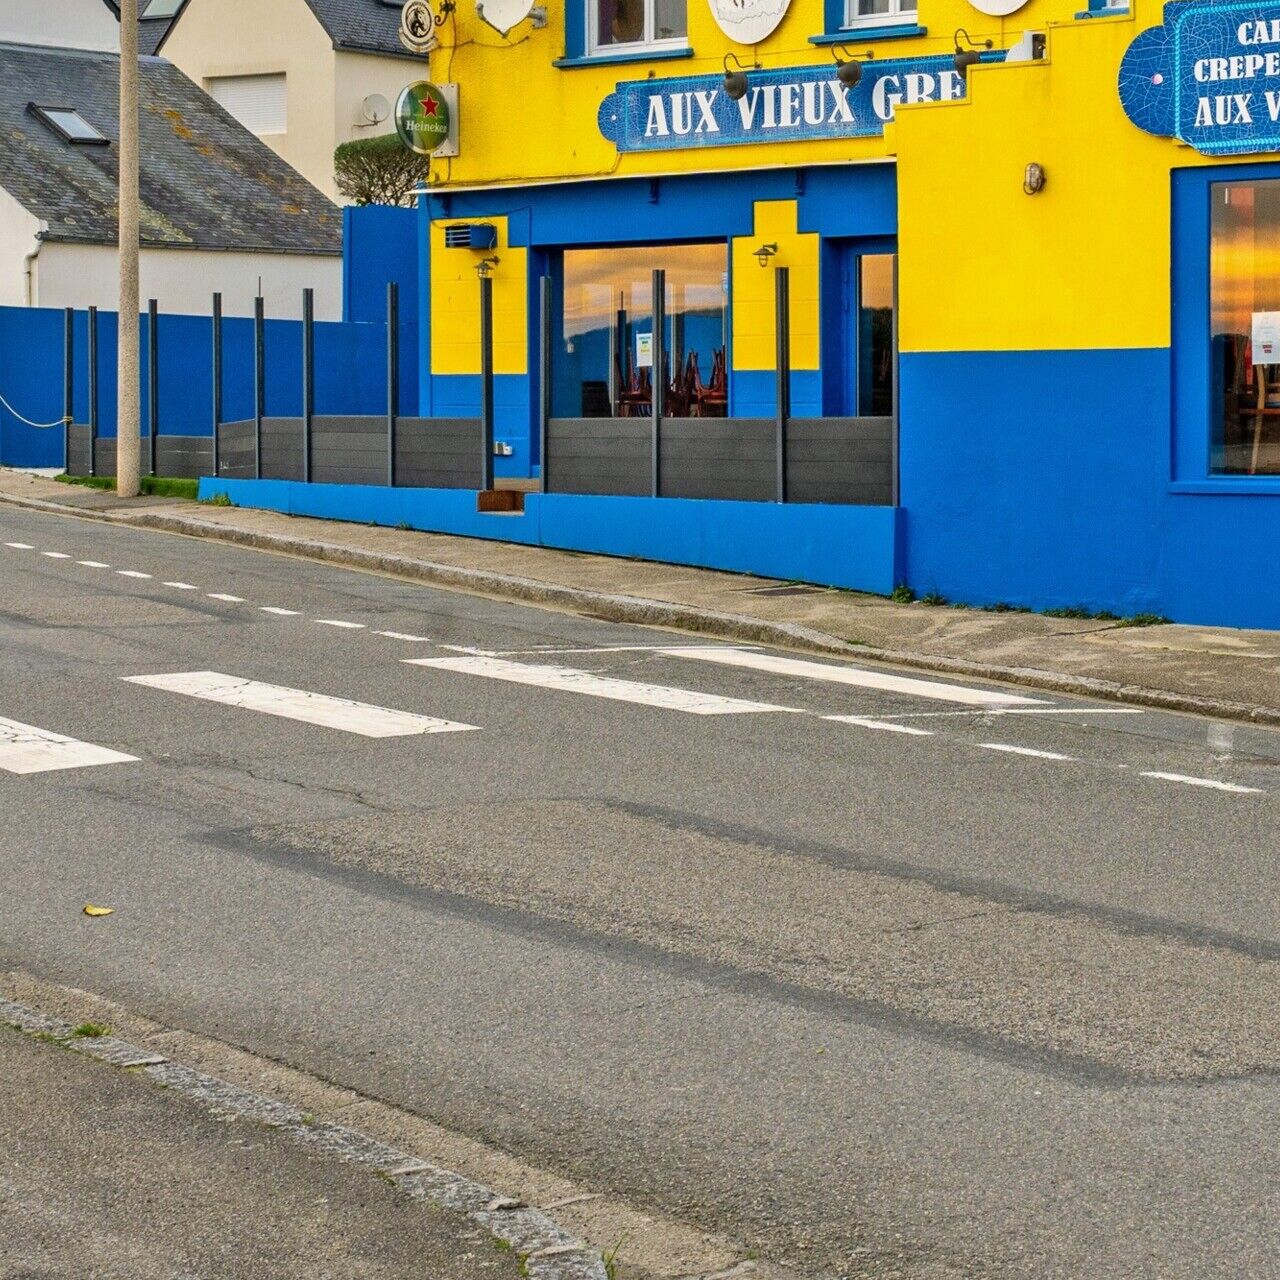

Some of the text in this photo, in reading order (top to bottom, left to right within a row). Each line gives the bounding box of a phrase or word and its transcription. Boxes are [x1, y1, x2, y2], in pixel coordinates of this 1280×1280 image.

[644, 90, 719, 137] AUX
[737, 80, 855, 130] VIEUX
[1194, 93, 1253, 127] AUX
